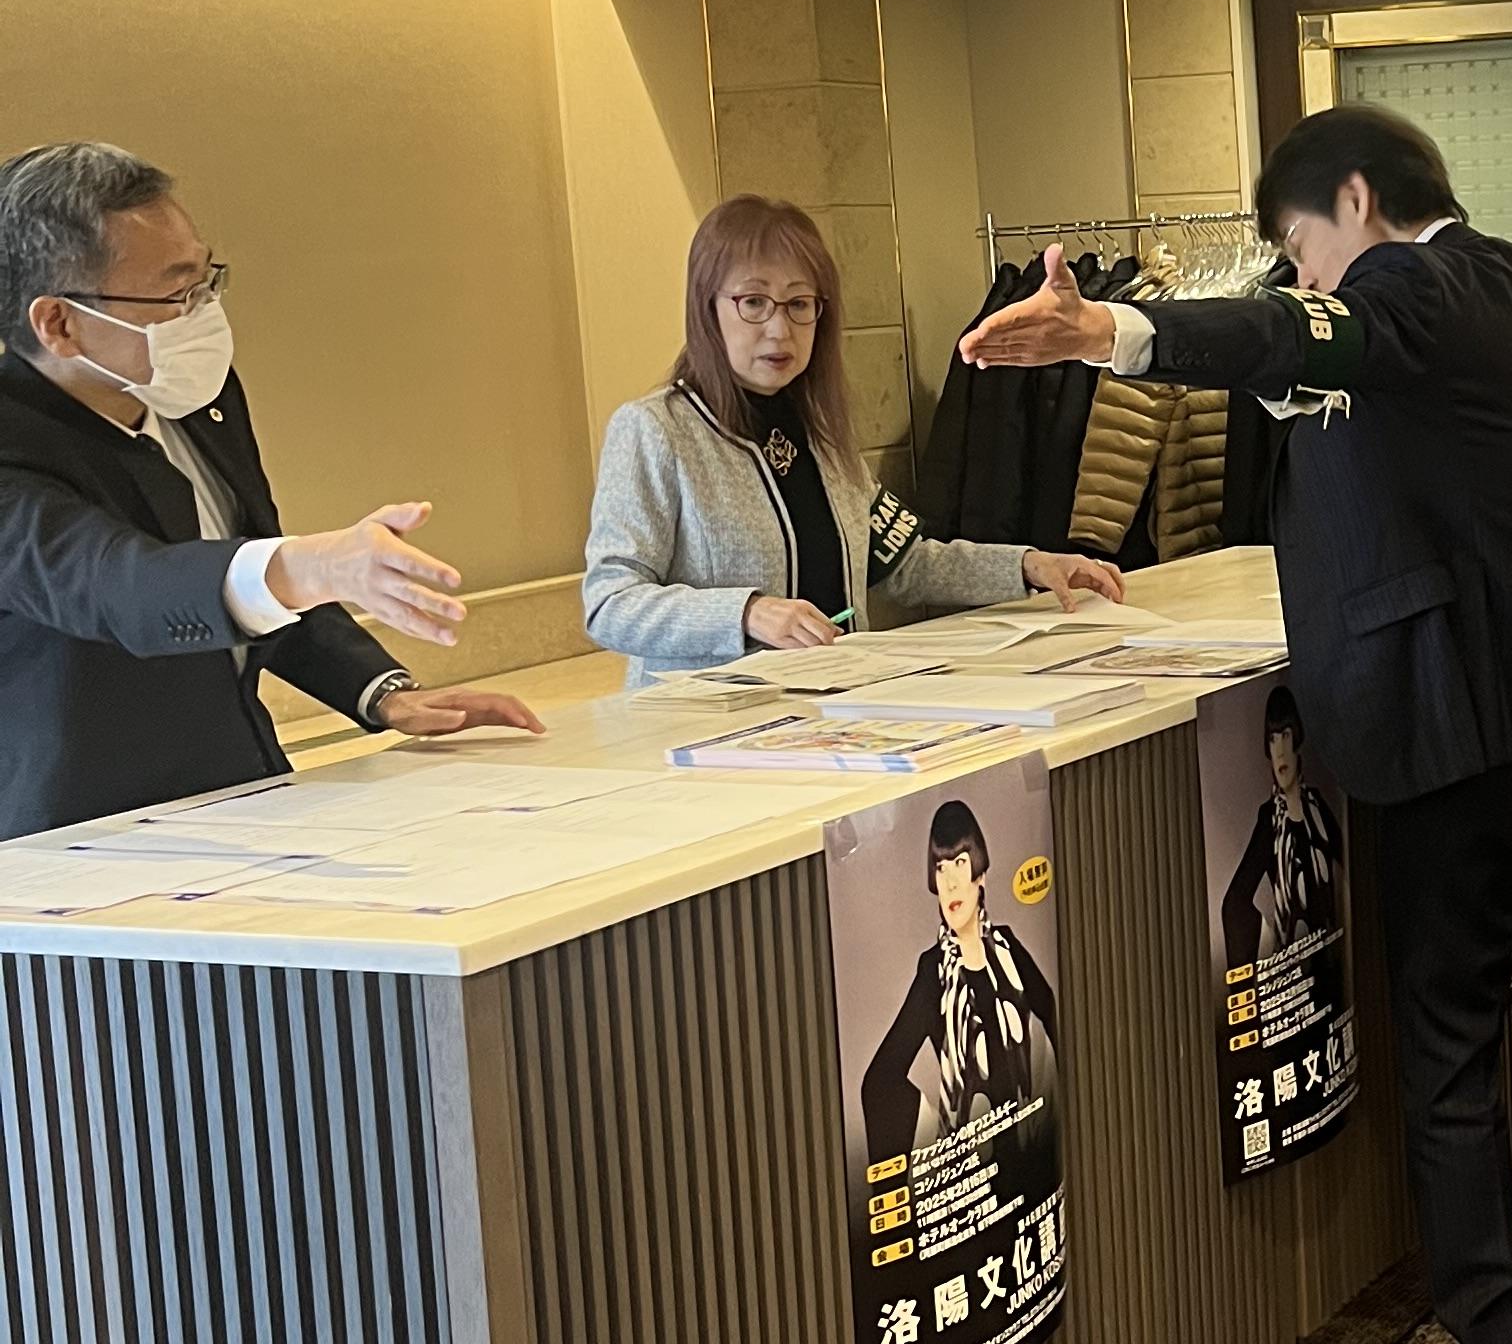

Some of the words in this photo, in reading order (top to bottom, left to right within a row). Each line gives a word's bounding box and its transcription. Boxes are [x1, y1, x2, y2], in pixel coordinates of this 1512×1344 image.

[870, 491, 900, 535] RAK
[874, 509, 918, 564] LIONS
[871, 1158, 904, 1179] テーマ
[1006, 1273, 1043, 1315] JUNKO
